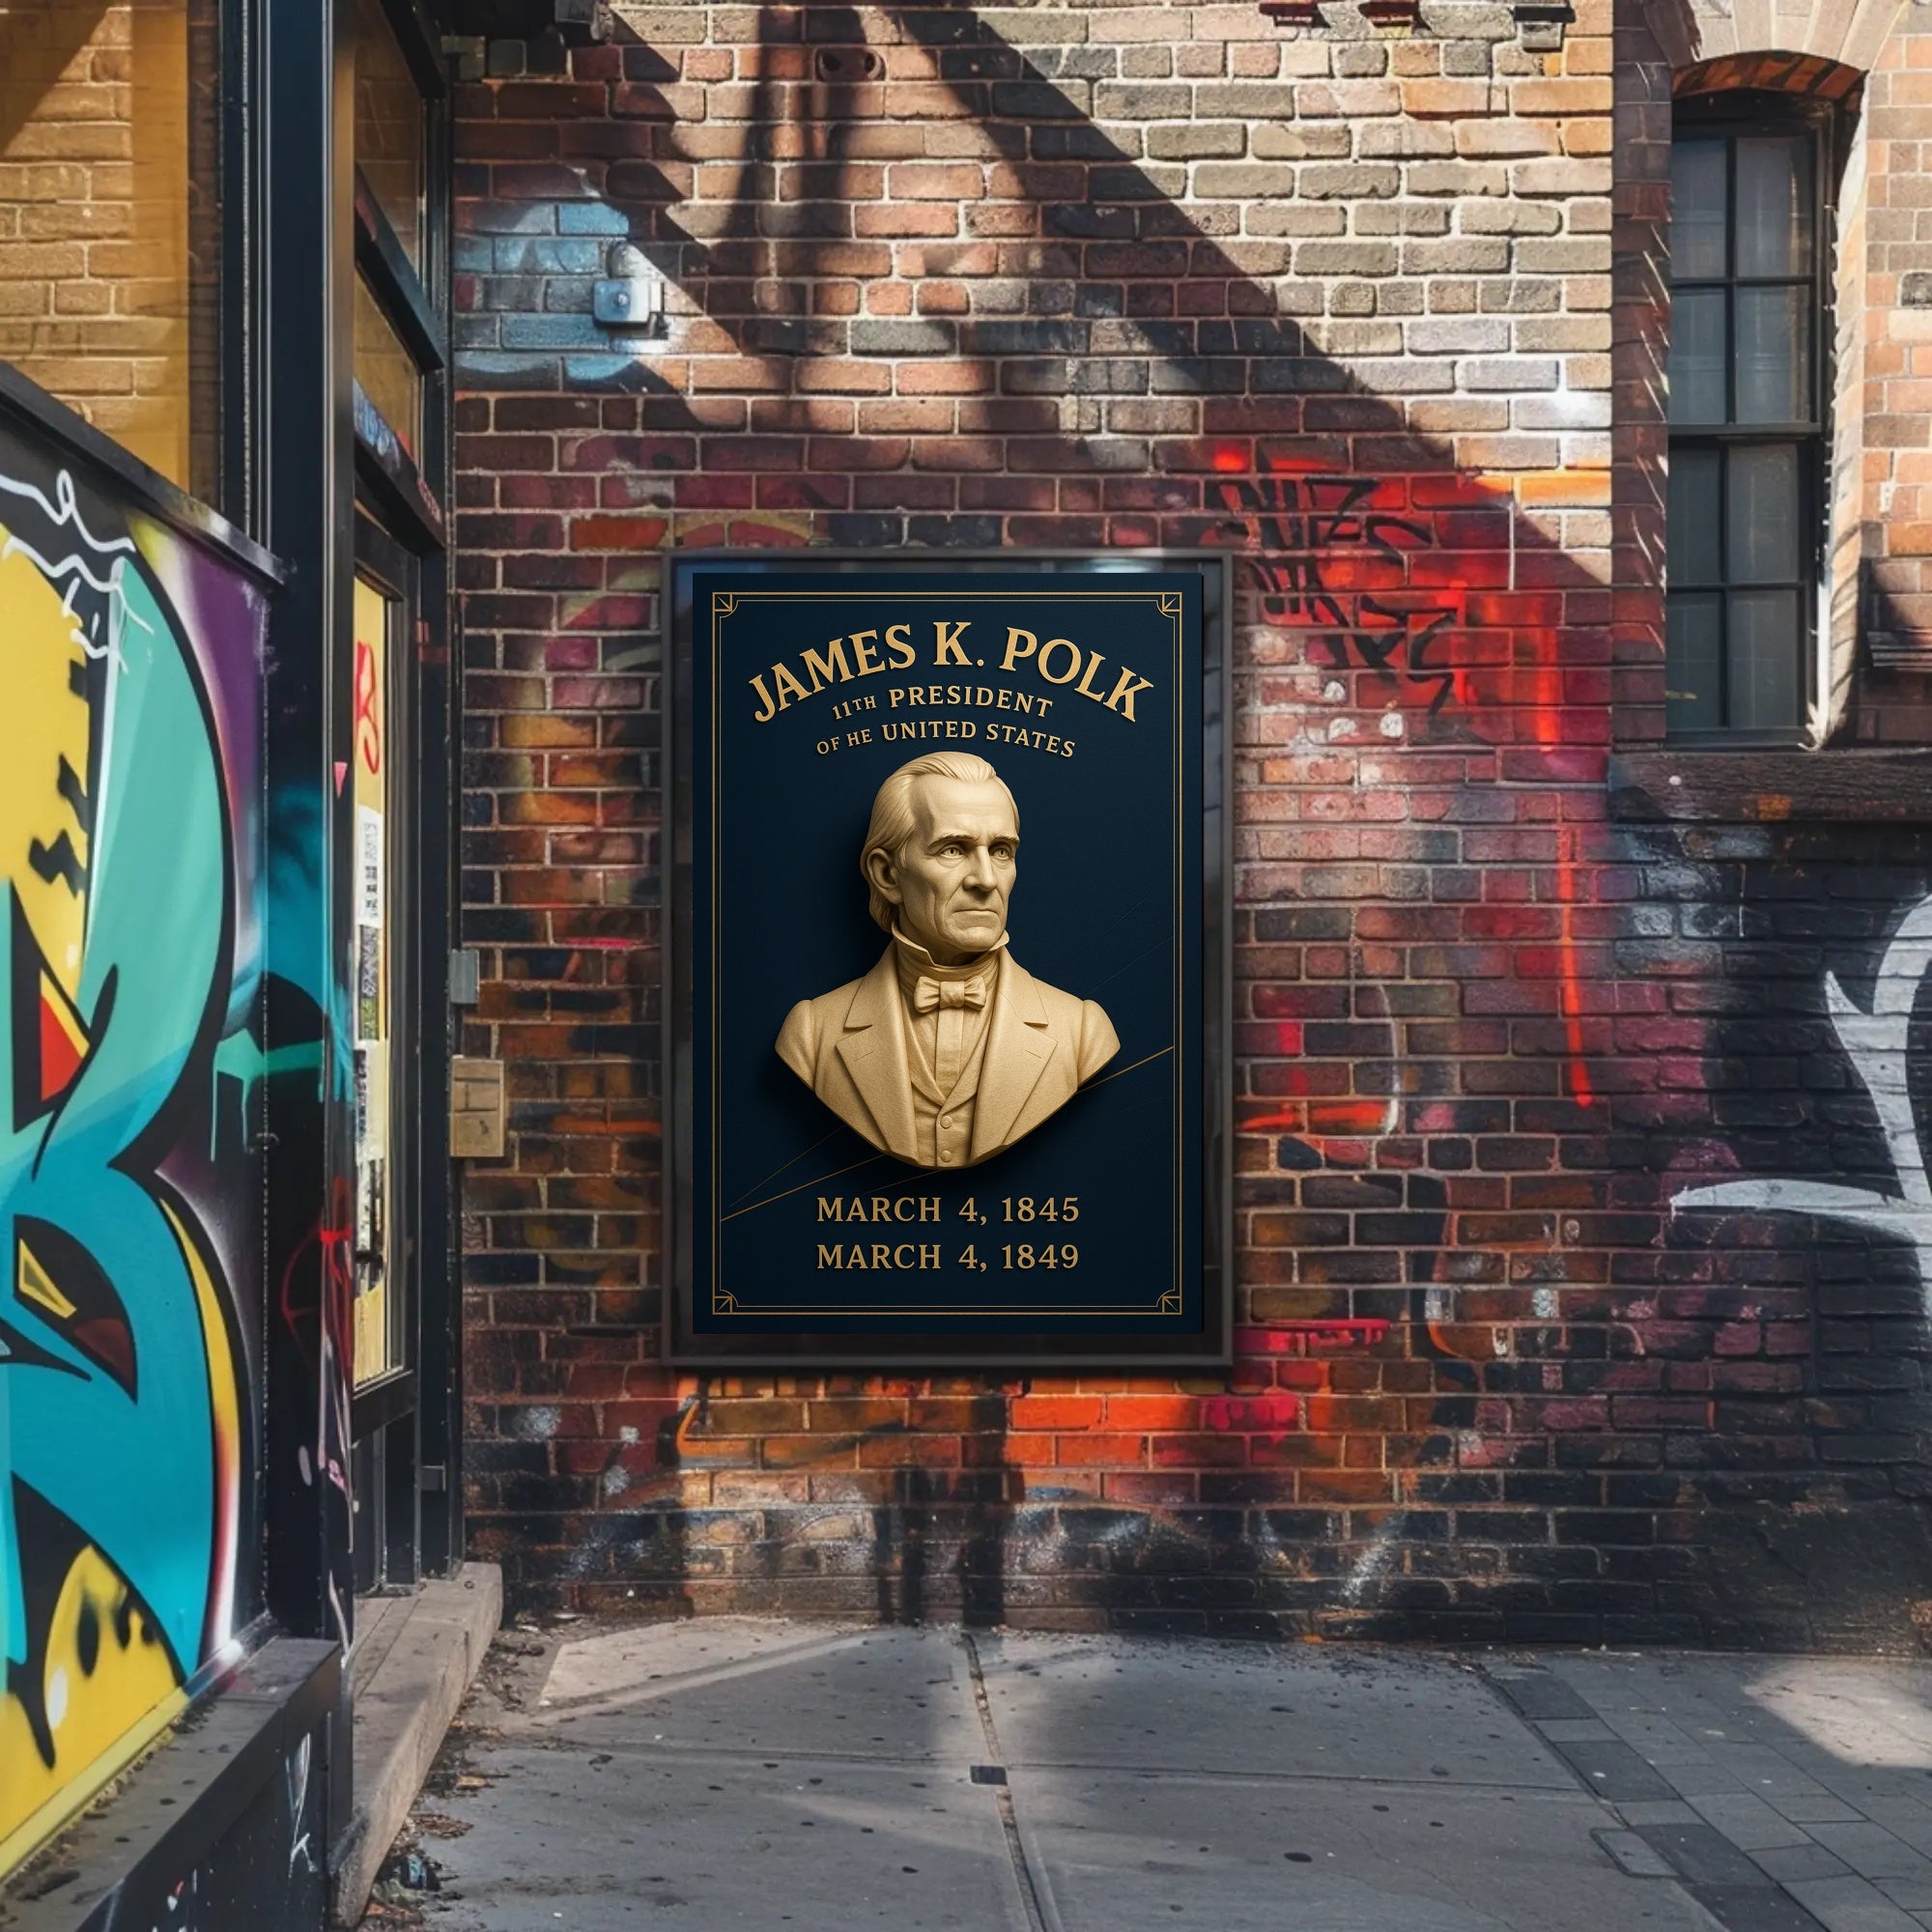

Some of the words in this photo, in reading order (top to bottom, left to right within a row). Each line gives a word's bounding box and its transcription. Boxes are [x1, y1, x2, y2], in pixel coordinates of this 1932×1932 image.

[748, 624, 917, 724] JAMES
[933, 621, 984, 668] K.
[999, 627, 1154, 723] POLK
[832, 695, 877, 721] 11TH
[889, 685, 1053, 718] PRESIDENT
[816, 736, 839, 755] OF
[846, 727, 872, 748] HE
[882, 721, 977, 741] UNITED
[986, 724, 1075, 758] STATES
[816, 1197, 941, 1222] MARCH
[958, 1197, 987, 1225] 4,
[1002, 1197, 1080, 1222] 1845
[816, 1244, 941, 1269] MARCH
[958, 1244, 987, 1272] 4,
[1002, 1244, 1079, 1269] 1849
